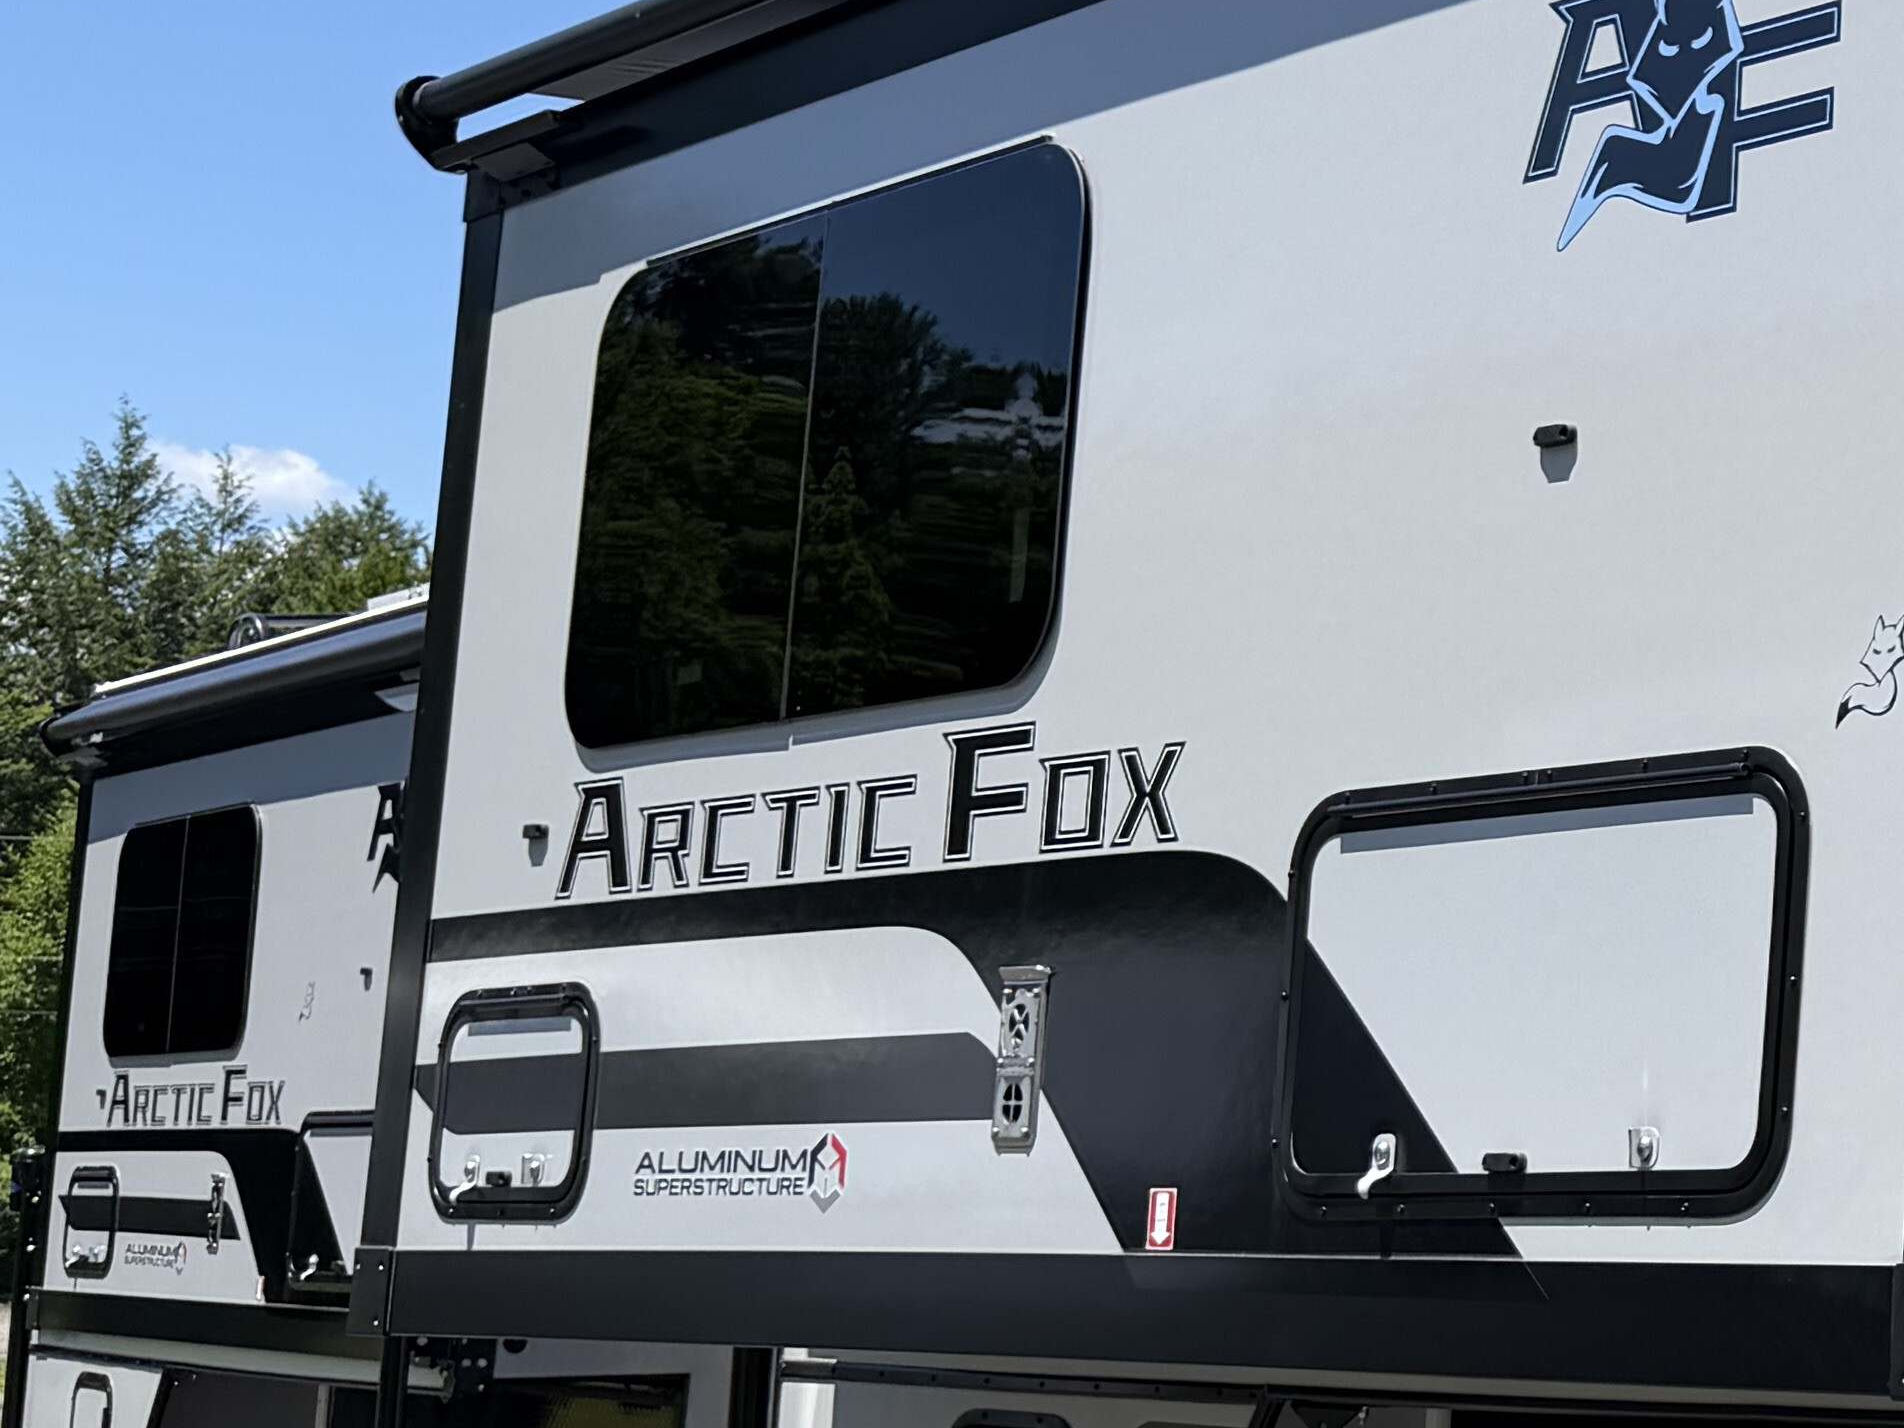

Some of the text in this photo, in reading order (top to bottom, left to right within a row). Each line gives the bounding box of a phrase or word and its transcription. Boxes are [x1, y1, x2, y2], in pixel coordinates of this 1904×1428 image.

[555, 721, 1187, 901] ARCTIC FOX
[106, 1064, 285, 1128] ARCTIC FOX
[634, 1148, 808, 1175] ALUMINUM
[633, 1177, 805, 1197] SUPERSTRUCTURE
